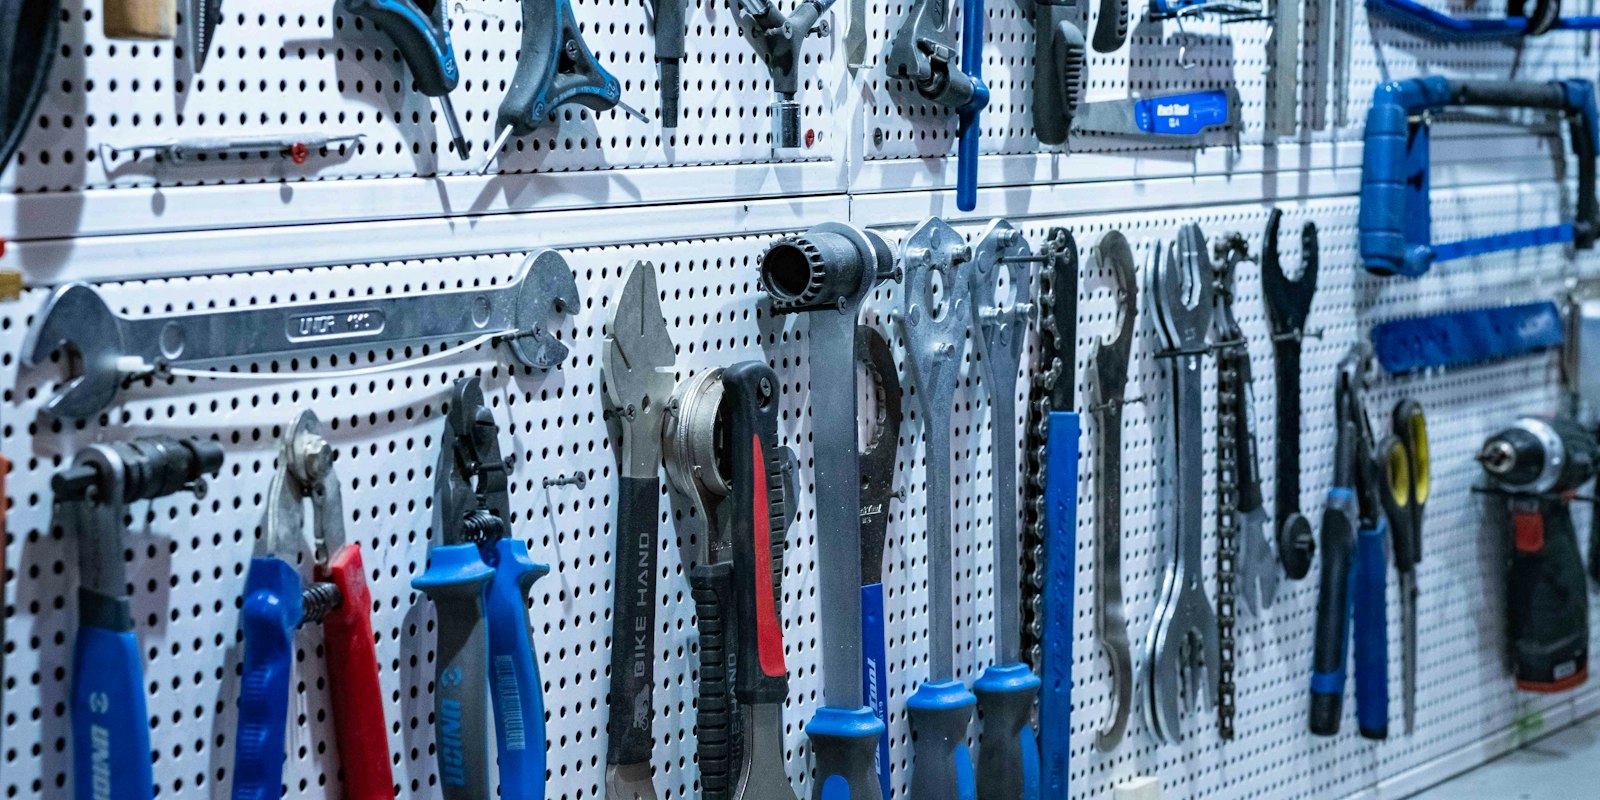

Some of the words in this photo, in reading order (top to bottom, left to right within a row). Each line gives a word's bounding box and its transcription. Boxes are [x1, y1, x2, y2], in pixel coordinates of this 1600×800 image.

[636, 532, 650, 606] HAND
[634, 616, 647, 678] BIKE
[90, 725, 111, 800] UNIO
[731, 721, 741, 772] BIKE
